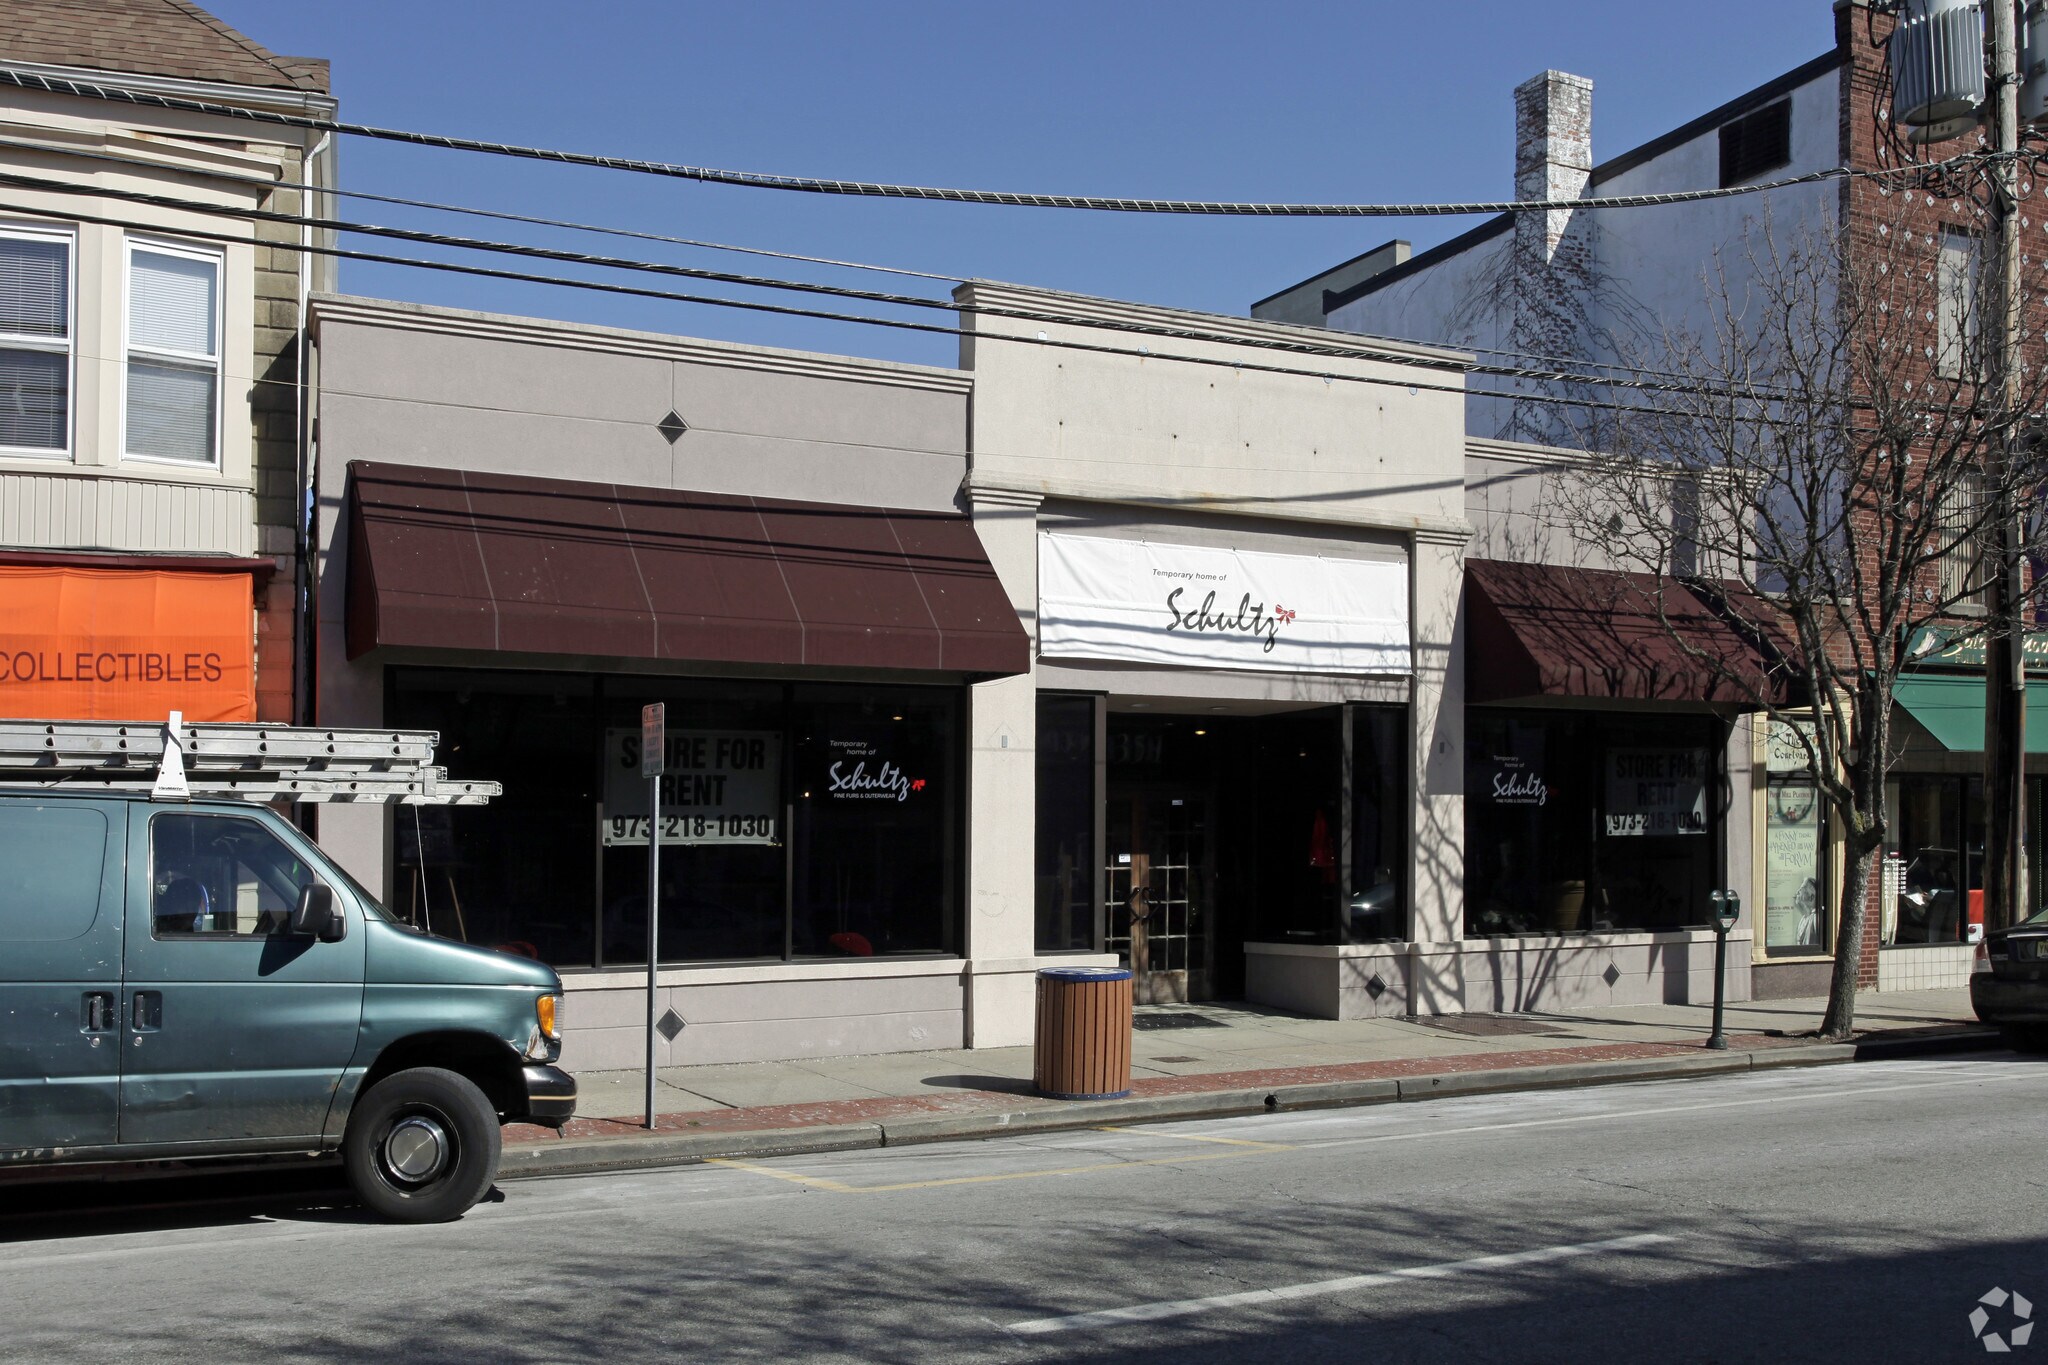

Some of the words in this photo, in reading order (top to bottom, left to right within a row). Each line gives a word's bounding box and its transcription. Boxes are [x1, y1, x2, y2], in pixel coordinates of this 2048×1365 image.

[1152, 568, 1194, 580] Temporary
[1195, 572, 1217, 581] home
[1218, 573, 1227, 582] of
[1166, 587, 1279, 653] Schultz
[620, 736, 707, 769] SORE
[716, 737, 765, 770] FOR
[829, 740, 868, 748] Temporary
[1616, 754, 1664, 779] STORE
[659, 774, 728, 806] RENT
[828, 760, 911, 802] Schultz
[1492, 772, 1548, 806] Schultz
[1637, 781, 1677, 807] RENT
[612, 814, 770, 838] 973-218-1030
[1612, 811, 1702, 831] 973-218-1030
